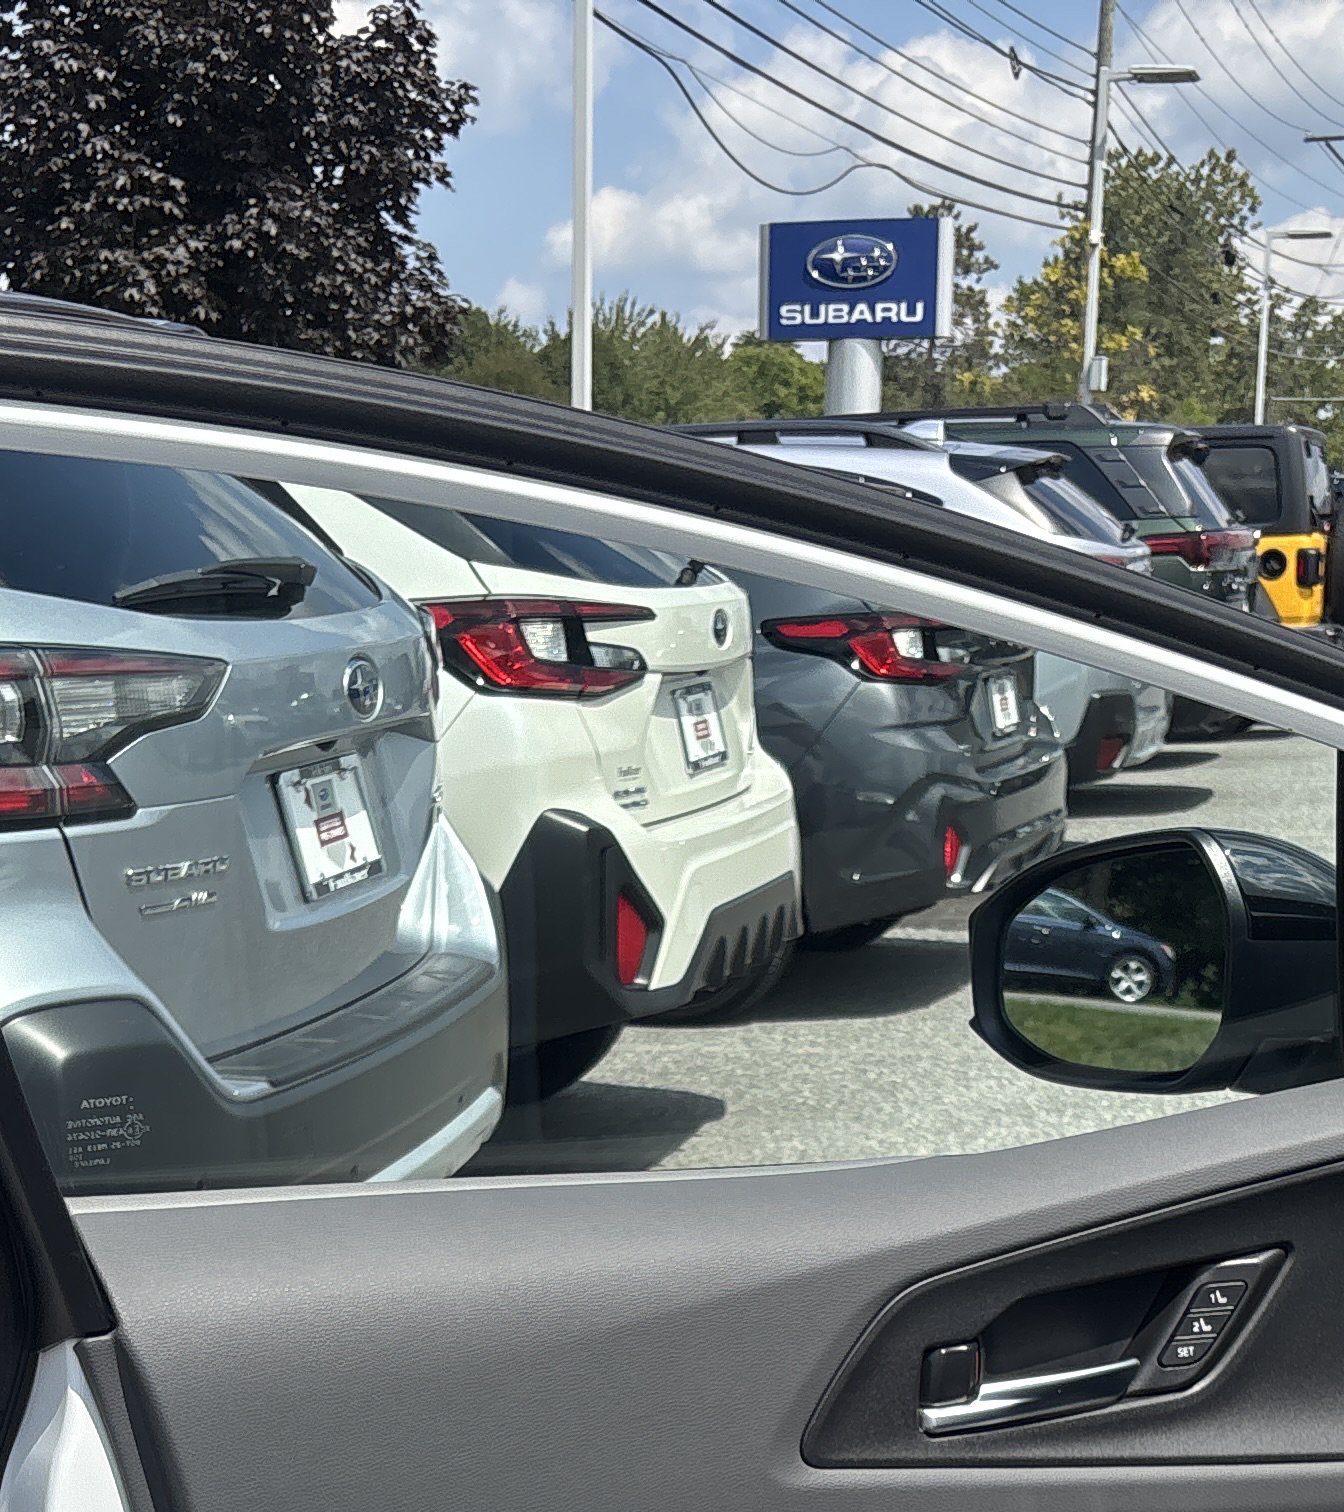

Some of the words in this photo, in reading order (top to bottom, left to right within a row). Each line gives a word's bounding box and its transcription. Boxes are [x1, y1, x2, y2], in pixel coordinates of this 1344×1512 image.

[779, 301, 925, 326] SUBARU
[1209, 1293, 1215, 1303] 1
[1192, 1322, 1200, 1332] 2
[1177, 1346, 1195, 1358] SET
